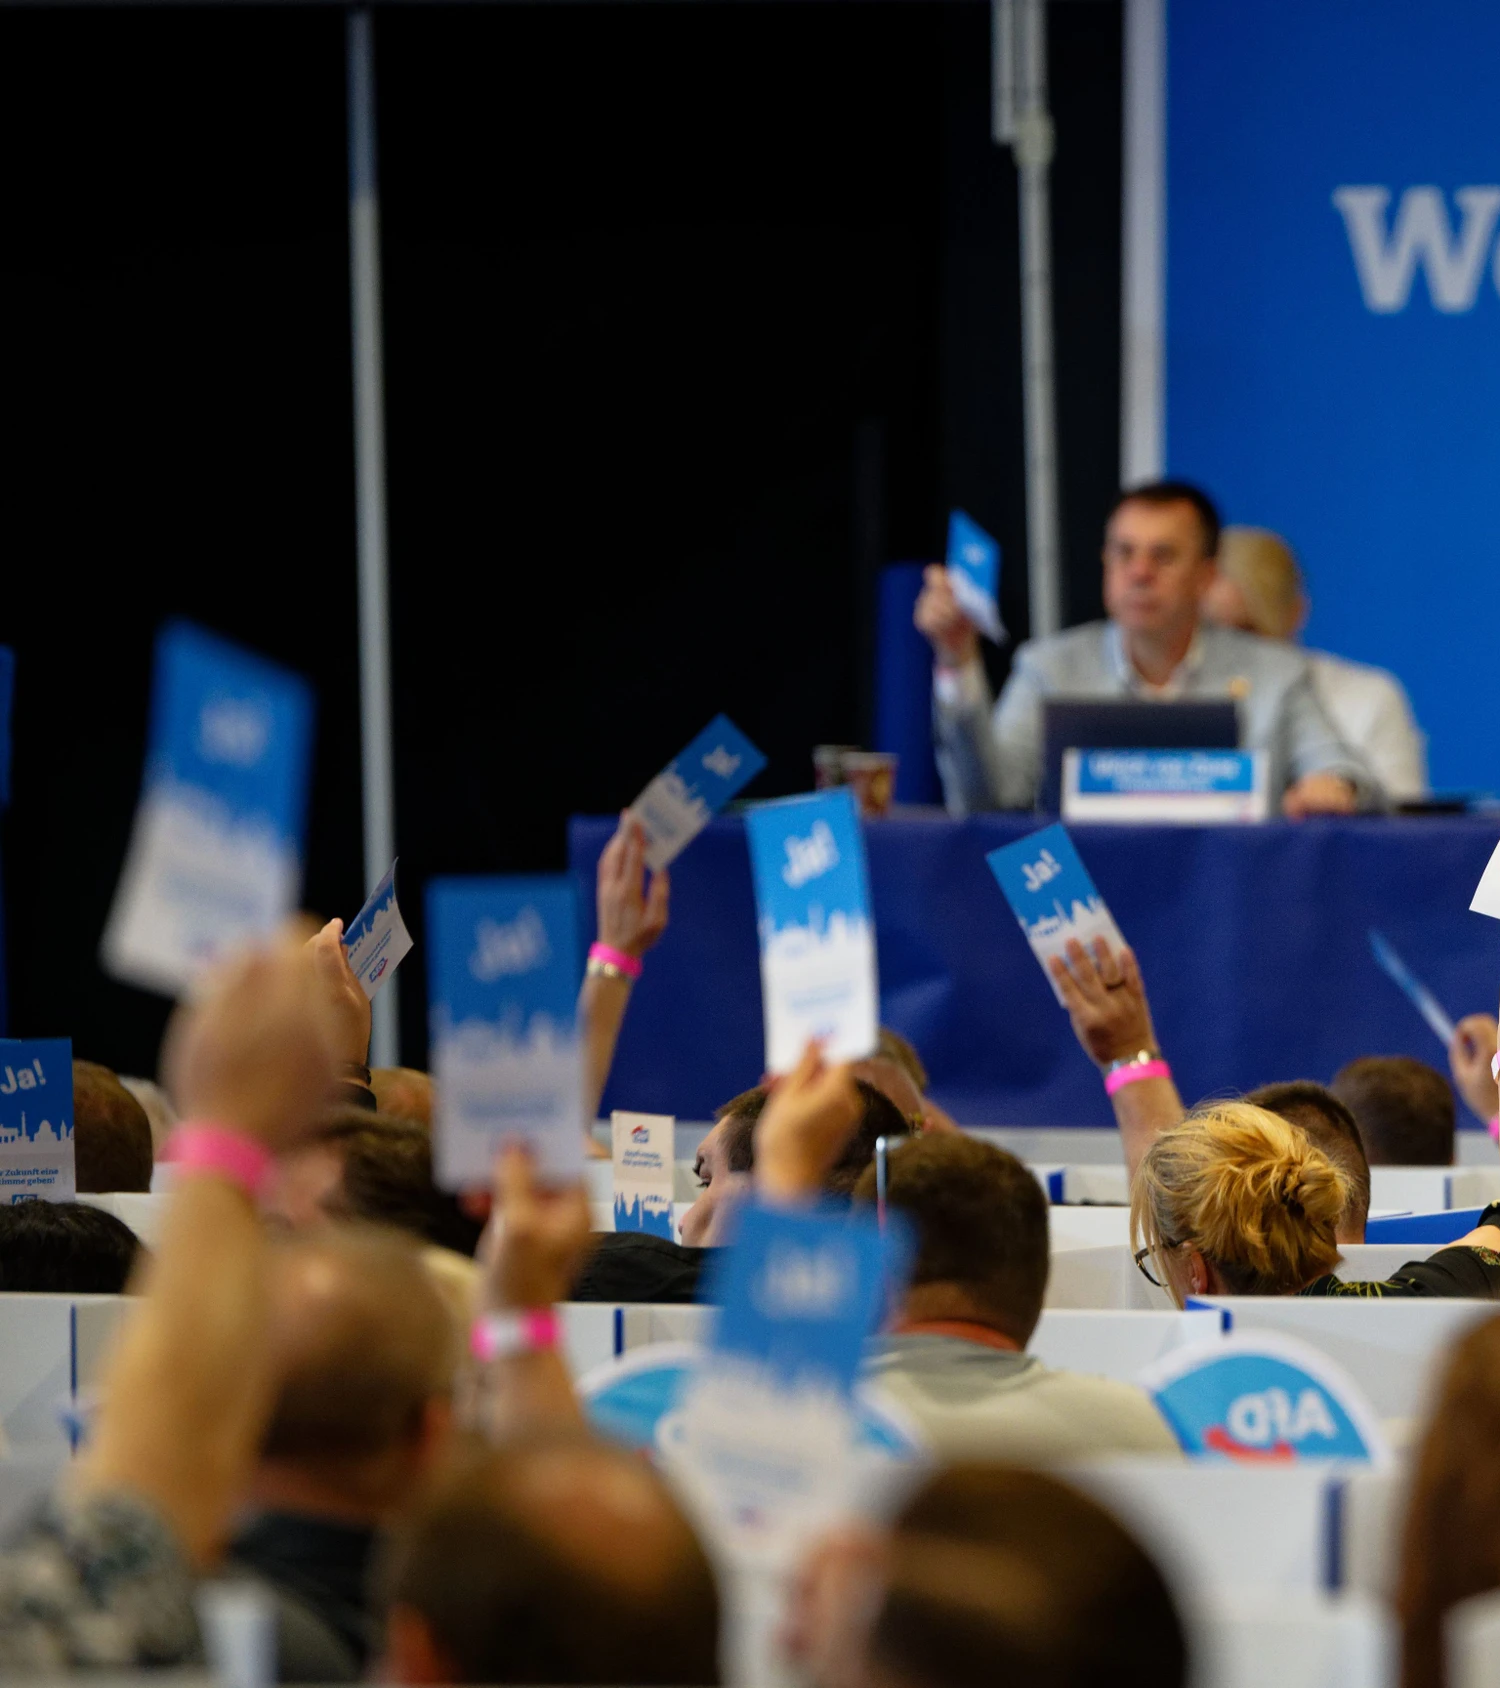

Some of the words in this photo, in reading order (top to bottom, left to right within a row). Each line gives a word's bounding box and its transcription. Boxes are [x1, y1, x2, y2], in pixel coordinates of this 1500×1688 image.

[1021, 848, 1062, 893] Ja!
[0, 1058, 47, 1095] Ja!
[5, 1168, 40, 1177] Zukunft
[40, 1168, 59, 1176] eine
[26, 1177, 56, 1187] geben!
